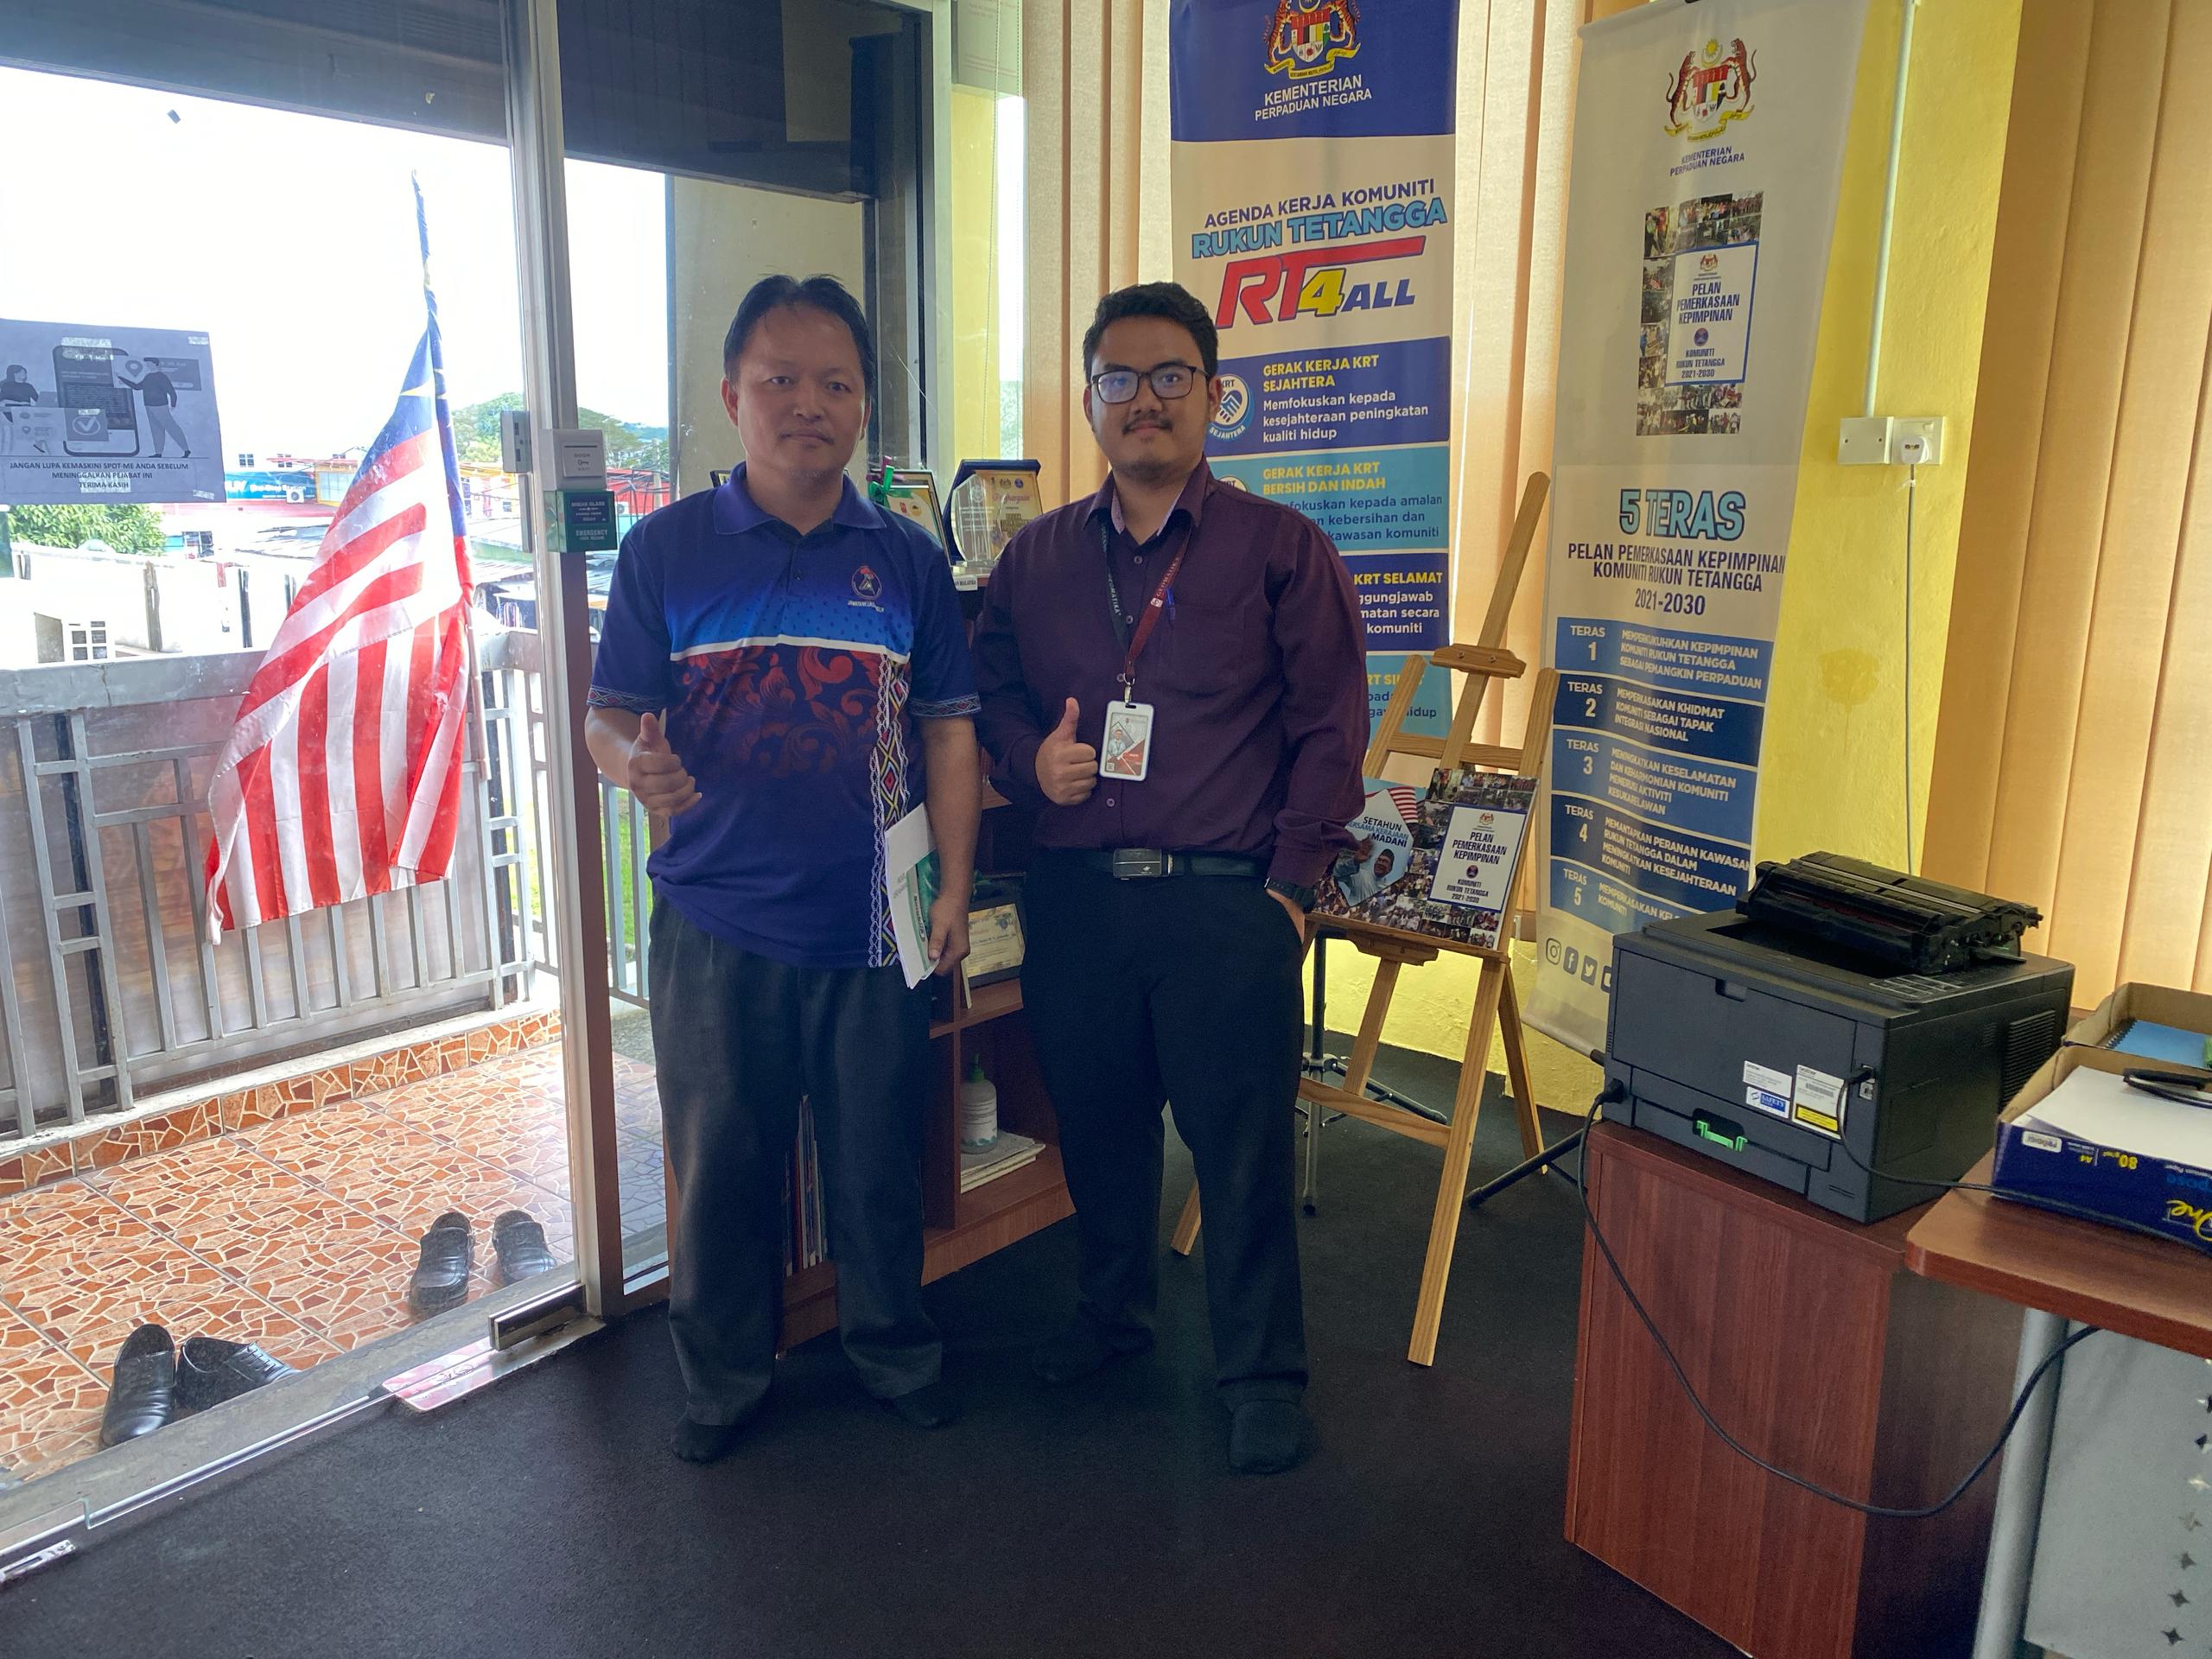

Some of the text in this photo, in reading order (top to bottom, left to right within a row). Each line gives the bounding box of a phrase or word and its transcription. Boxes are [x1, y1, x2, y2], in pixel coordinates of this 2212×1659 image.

[1264, 74, 1362, 105] KEMENTERIAN
[1255, 88, 1372, 121] PERPADUAN NEGARA
[1669, 153, 1745, 176] PERPADUAN NEGARA
[1681, 146, 1732, 164] KEMENTERIAN
[1205, 178, 1434, 228] AGENDA KERJA KOMUNITI
[1192, 197, 1448, 259] RUKUN TETANGGA
[1692, 282, 1721, 296] PELAN
[1677, 294, 1740, 312] PEMERKASAAN
[1679, 308, 1732, 325] KEPIMPINAN
[1686, 348, 1714, 358] KOMUNITI
[1695, 358, 1725, 367] TETANGGA
[1263, 354, 1380, 377] GERAK KERJA KRT
[1263, 374, 1336, 393] SEJAHTERA
[1263, 391, 1396, 411] Memfokuskan kepada
[1263, 405, 1428, 427] kesejahteraan peningkatan
[1210, 424, 1245, 439] SEJAHTERA
[1263, 428, 1338, 443] kualiti hidup
[1263, 461, 1380, 480] GERAK KERJA KRT
[1263, 478, 1386, 496] BERSIH DAN INDAH
[1287, 495, 1442, 512] fokuskan kepada amalan
[1328, 512, 1398, 526] kebersihan
[1402, 512, 1425, 522] dan
[1619, 489, 1746, 541] 5 TERAS
[1328, 526, 1439, 541] kawasan komuniti
[1568, 543, 1786, 575] PELAN PEMERKASAAN KEPIMPINAN
[1354, 572, 1443, 585] KRT SELAMAT
[1593, 562, 1762, 593] KOMUNITI RUKUN TETANGGA
[1635, 588, 1706, 616] 2021-2030
[1401, 607, 1440, 618] secara
[1367, 622, 1422, 633] komuniti
[1570, 626, 1605, 637] TERAS
[1588, 641, 1598, 661] 1
[1648, 647, 1676, 663] RUKUN
[1678, 653, 1736, 671] TETANGGA
[1690, 641, 1758, 659] KEPIMPINAN
[1567, 681, 1603, 695] TERAS
[1696, 671, 1762, 690] PERPADUAN
[1585, 697, 1597, 718] 2
[1677, 702, 1726, 719] KHIDMAT
[1643, 710, 1678, 726] SEBAGAI
[1680, 717, 1714, 733] TAPAK
[1644, 721, 1688, 741] NASIONAL
[1566, 739, 1599, 753] TERAS
[1583, 755, 1593, 775] 3
[1610, 760, 1624, 773] DAN
[1677, 781, 1728, 802] KOMUNITI
[1662, 764, 1737, 788] KESELAMATAN
[1638, 785, 1672, 803] AKTIVITI
[1565, 804, 1593, 820] TERAS
[1363, 817, 1402, 831] SETAHUN
[1579, 823, 1588, 842] 4
[1371, 833, 1408, 848] MADANI
[1376, 828, 1409, 840] KERAJAAN
[1470, 831, 1494, 843] PELAN
[1452, 839, 1507, 855] PEMERKASAAN
[1453, 849, 1500, 864] KEPIMPINAN
[1604, 829, 1697, 871] RUKUN TETANGGA DALAM
[1654, 836, 1699, 858] PERANAN
[1601, 854, 1631, 875] KOMUNITI
[1603, 842, 1737, 896] MENINGKATKAN KESEJAHTERAAN
[1563, 868, 1587, 886] TERAS
[1573, 887, 1582, 906] 5
[1598, 894, 1628, 917] KOMUNITI
